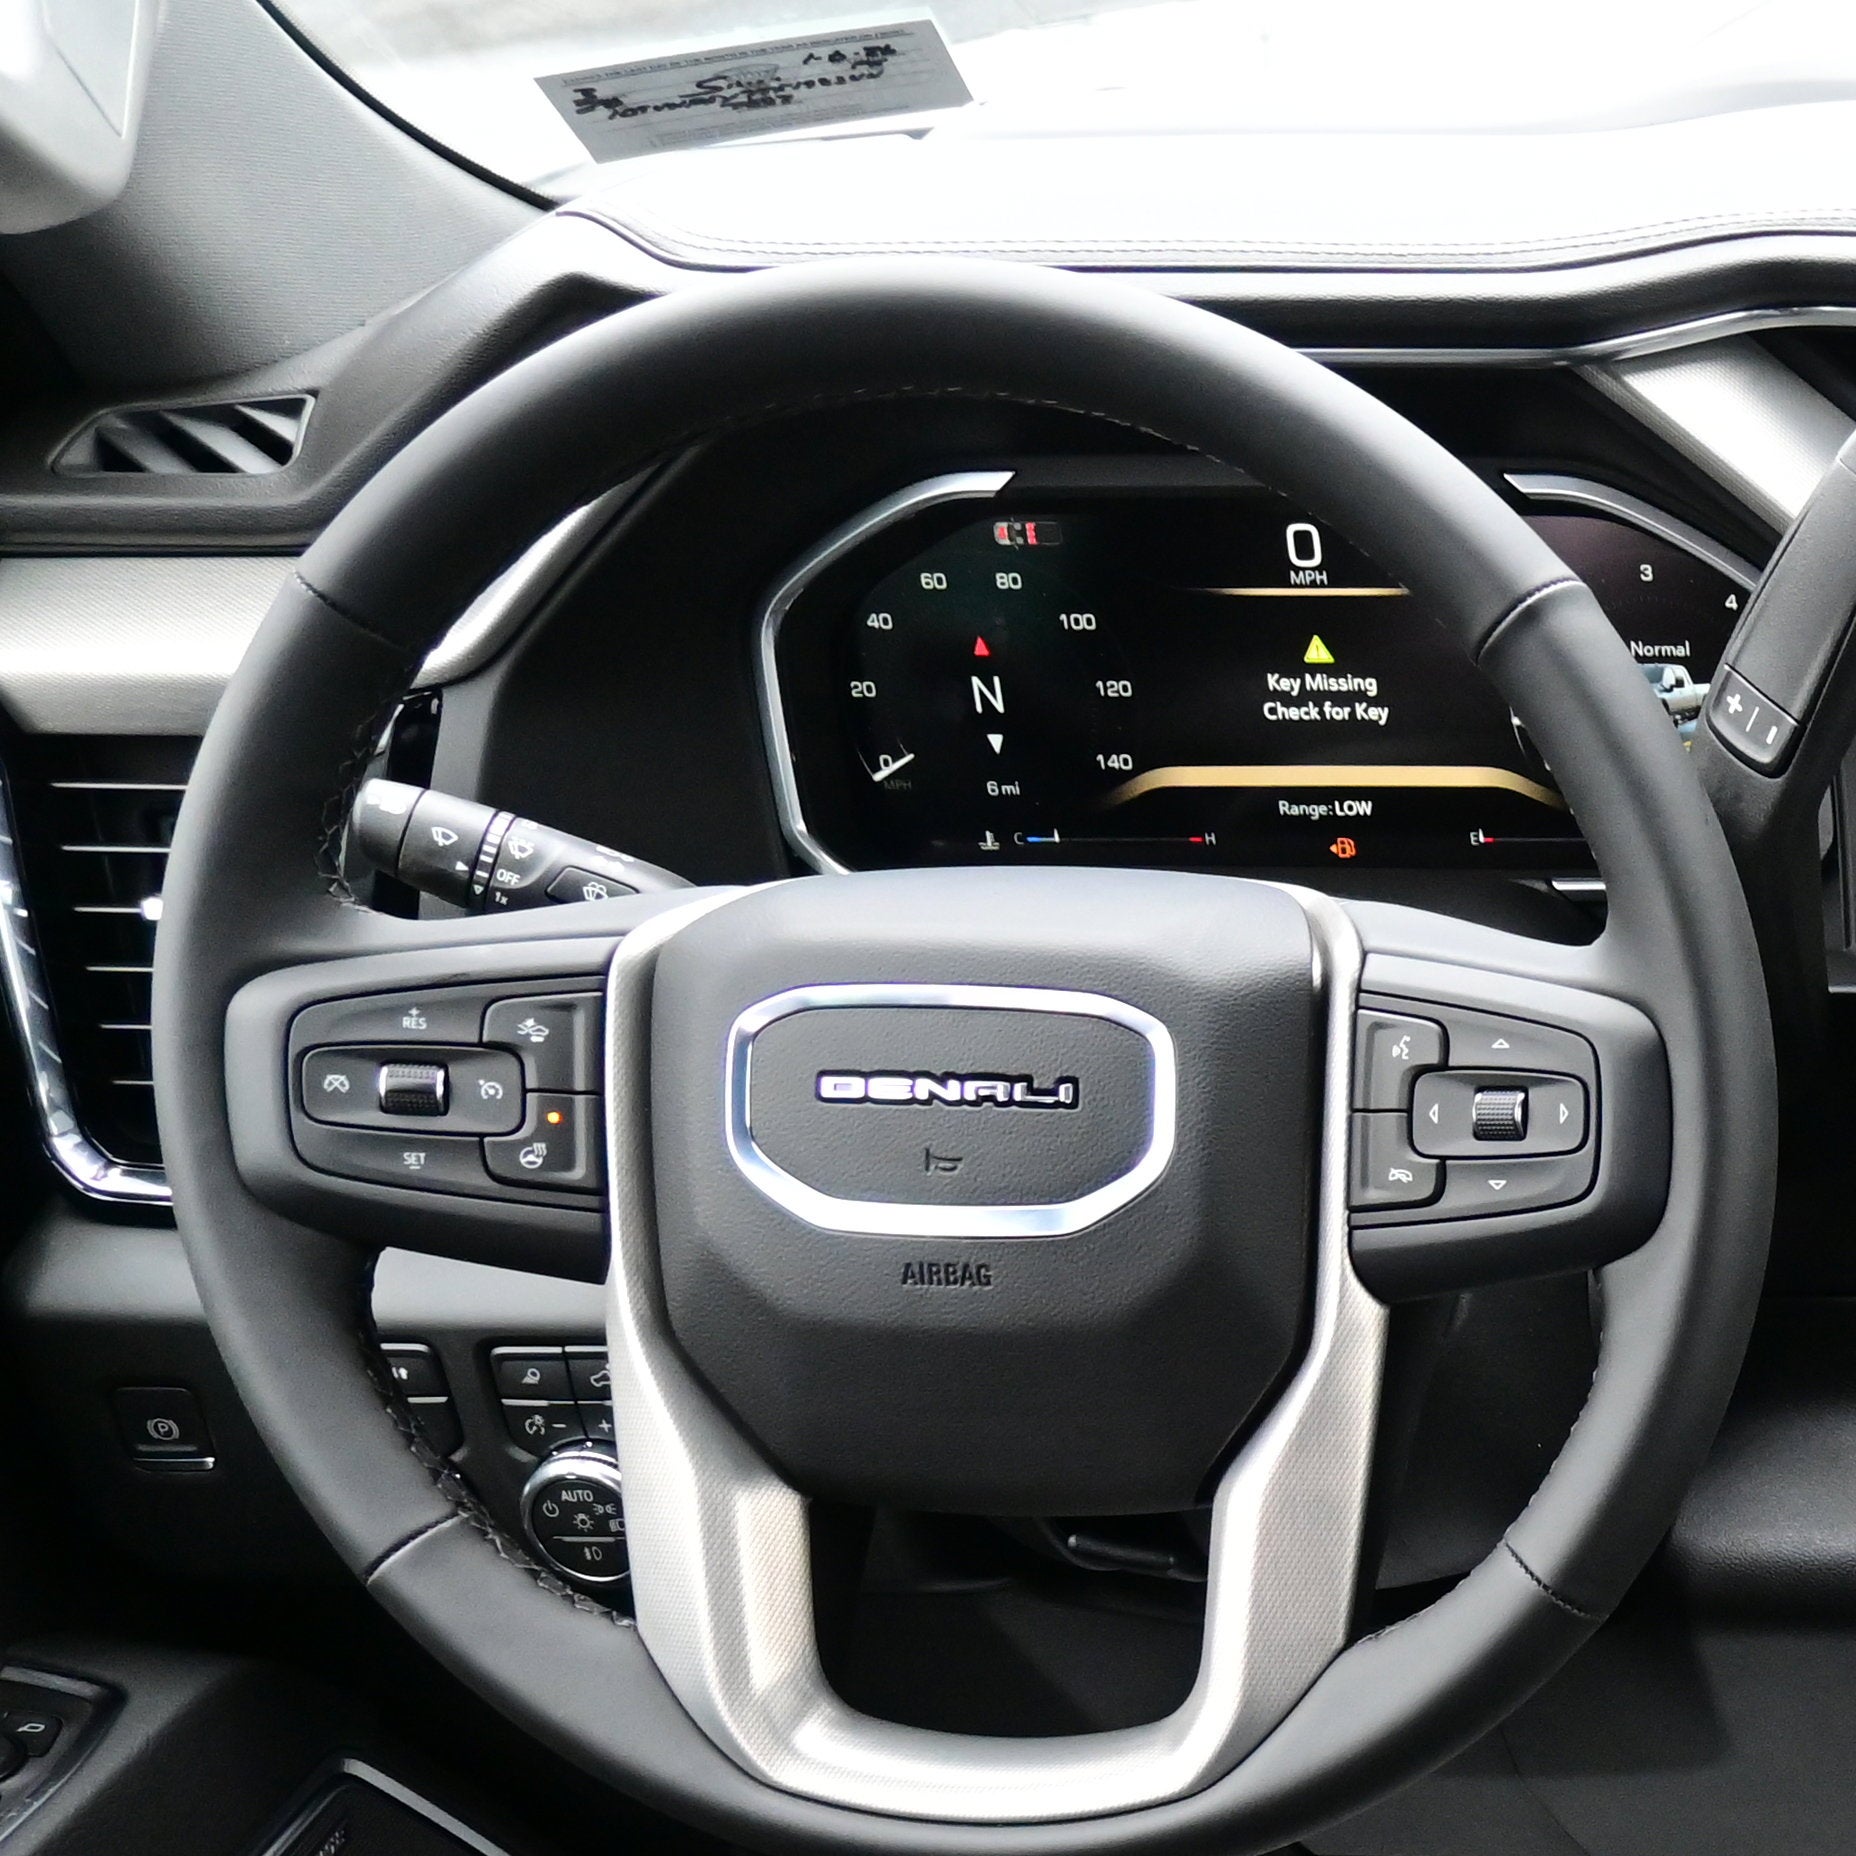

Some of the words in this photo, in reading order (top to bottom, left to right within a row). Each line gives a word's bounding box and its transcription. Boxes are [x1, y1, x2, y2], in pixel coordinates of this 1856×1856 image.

[1285, 523, 1322, 568] 0
[919, 572, 948, 590] 60
[995, 572, 1022, 590] 80
[1290, 570, 1328, 586] MPH
[1639, 565, 1654, 581] 3
[866, 613, 893, 630] 40
[1059, 613, 1097, 631] 100
[1630, 640, 1691, 658] Normal
[850, 681, 877, 698] 20
[1095, 680, 1133, 698] 120
[1267, 674, 1302, 693] Key
[1305, 673, 1378, 695] Missing
[971, 675, 1005, 714] N
[1263, 701, 1320, 721] Check
[1323, 702, 1352, 721] for
[1356, 703, 1389, 726] Key
[1096, 754, 1133, 771] 140
[1278, 801, 1333, 820] Range:
[1334, 801, 1373, 816] LOW
[496, 868, 520, 885] OFF
[402, 1017, 427, 1030] RES
[820, 1075, 1073, 1104] DENALI
[403, 1152, 426, 1165] SET
[901, 1262, 992, 1288] AIRBAG
[561, 1489, 594, 1502] AUTO
